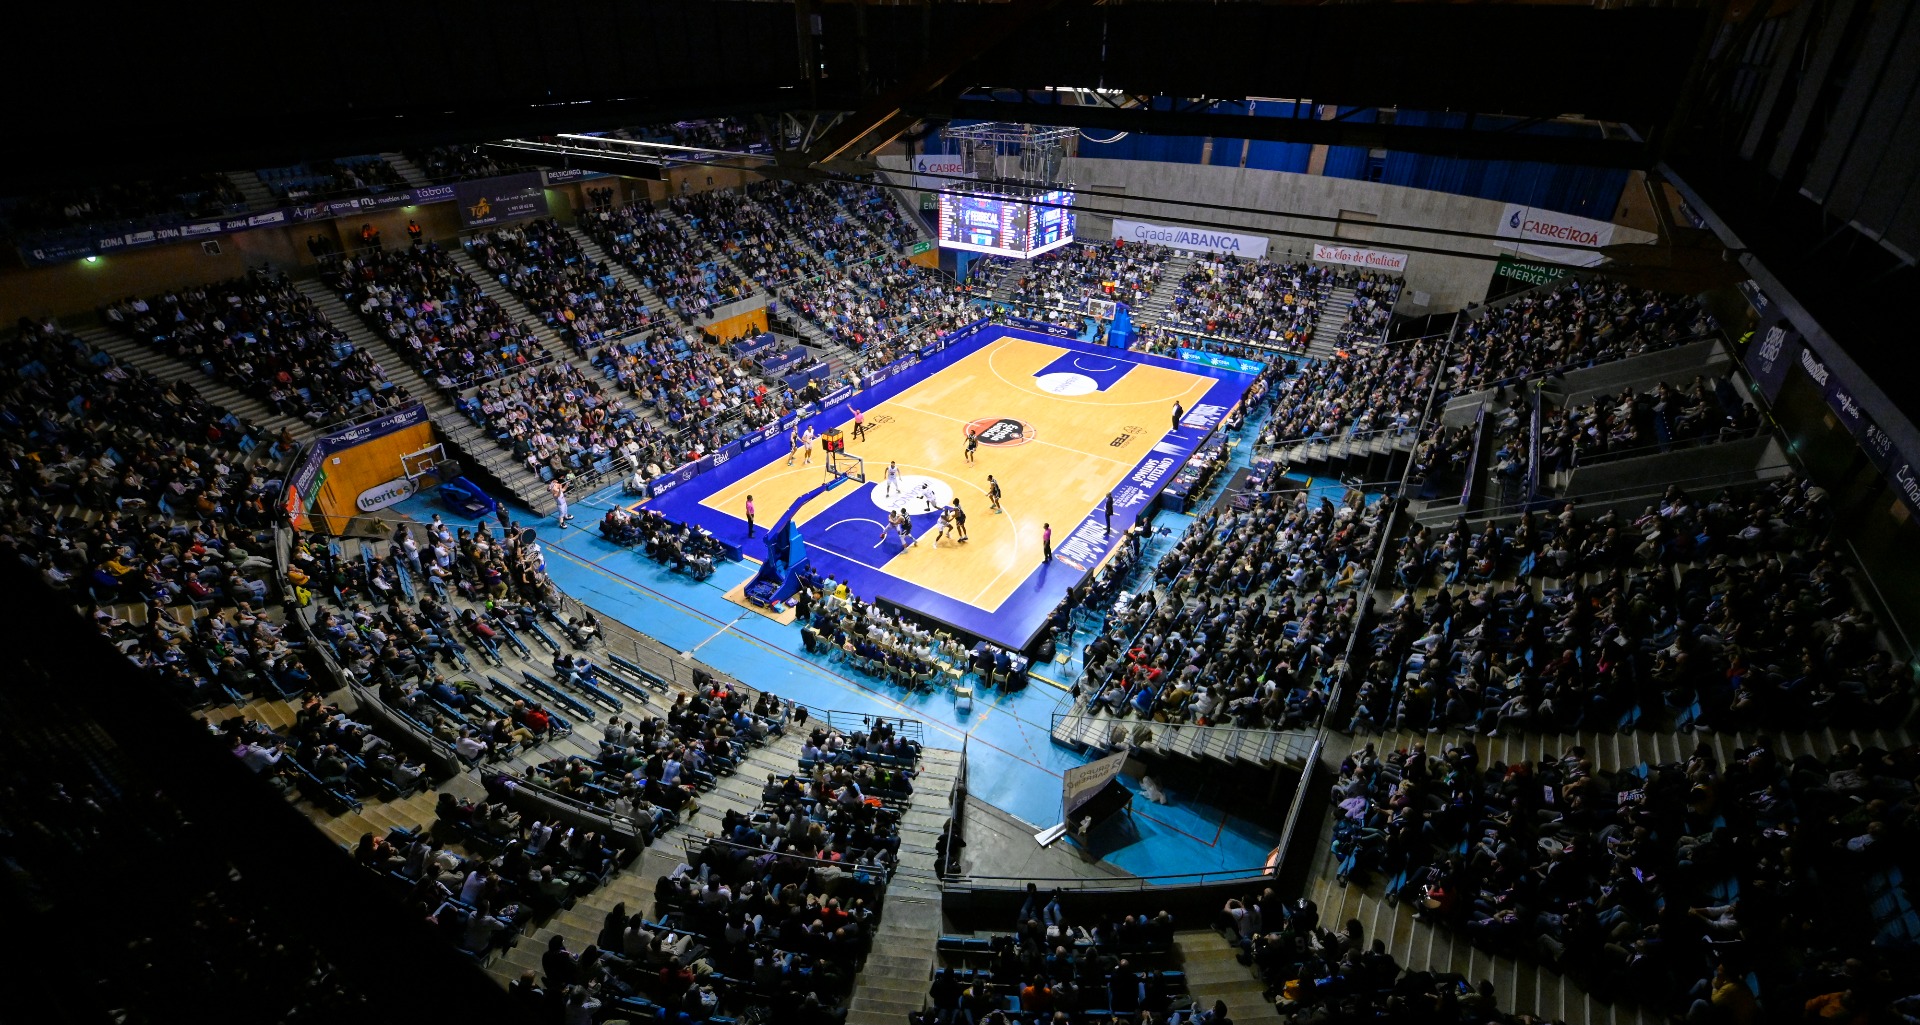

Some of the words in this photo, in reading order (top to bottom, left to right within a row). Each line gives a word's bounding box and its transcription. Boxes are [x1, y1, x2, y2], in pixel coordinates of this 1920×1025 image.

[929, 163, 962, 173] CABRE
[227, 219, 247, 230] ZONA
[100, 236, 124, 250] ZONA
[157, 228, 179, 240] ZONA
[1134, 225, 1173, 243] Grada
[1317, 246, 1332, 259] La
[1353, 251, 1364, 263] de
[1365, 252, 1401, 268] Galicia
[1499, 266, 1553, 286] EMERXEN
[1131, 458, 1160, 482] SANTIAGO
[1147, 457, 1175, 482] CONCELLO
[1139, 480, 1155, 489] DE
[360, 485, 411, 508] Iberitos
